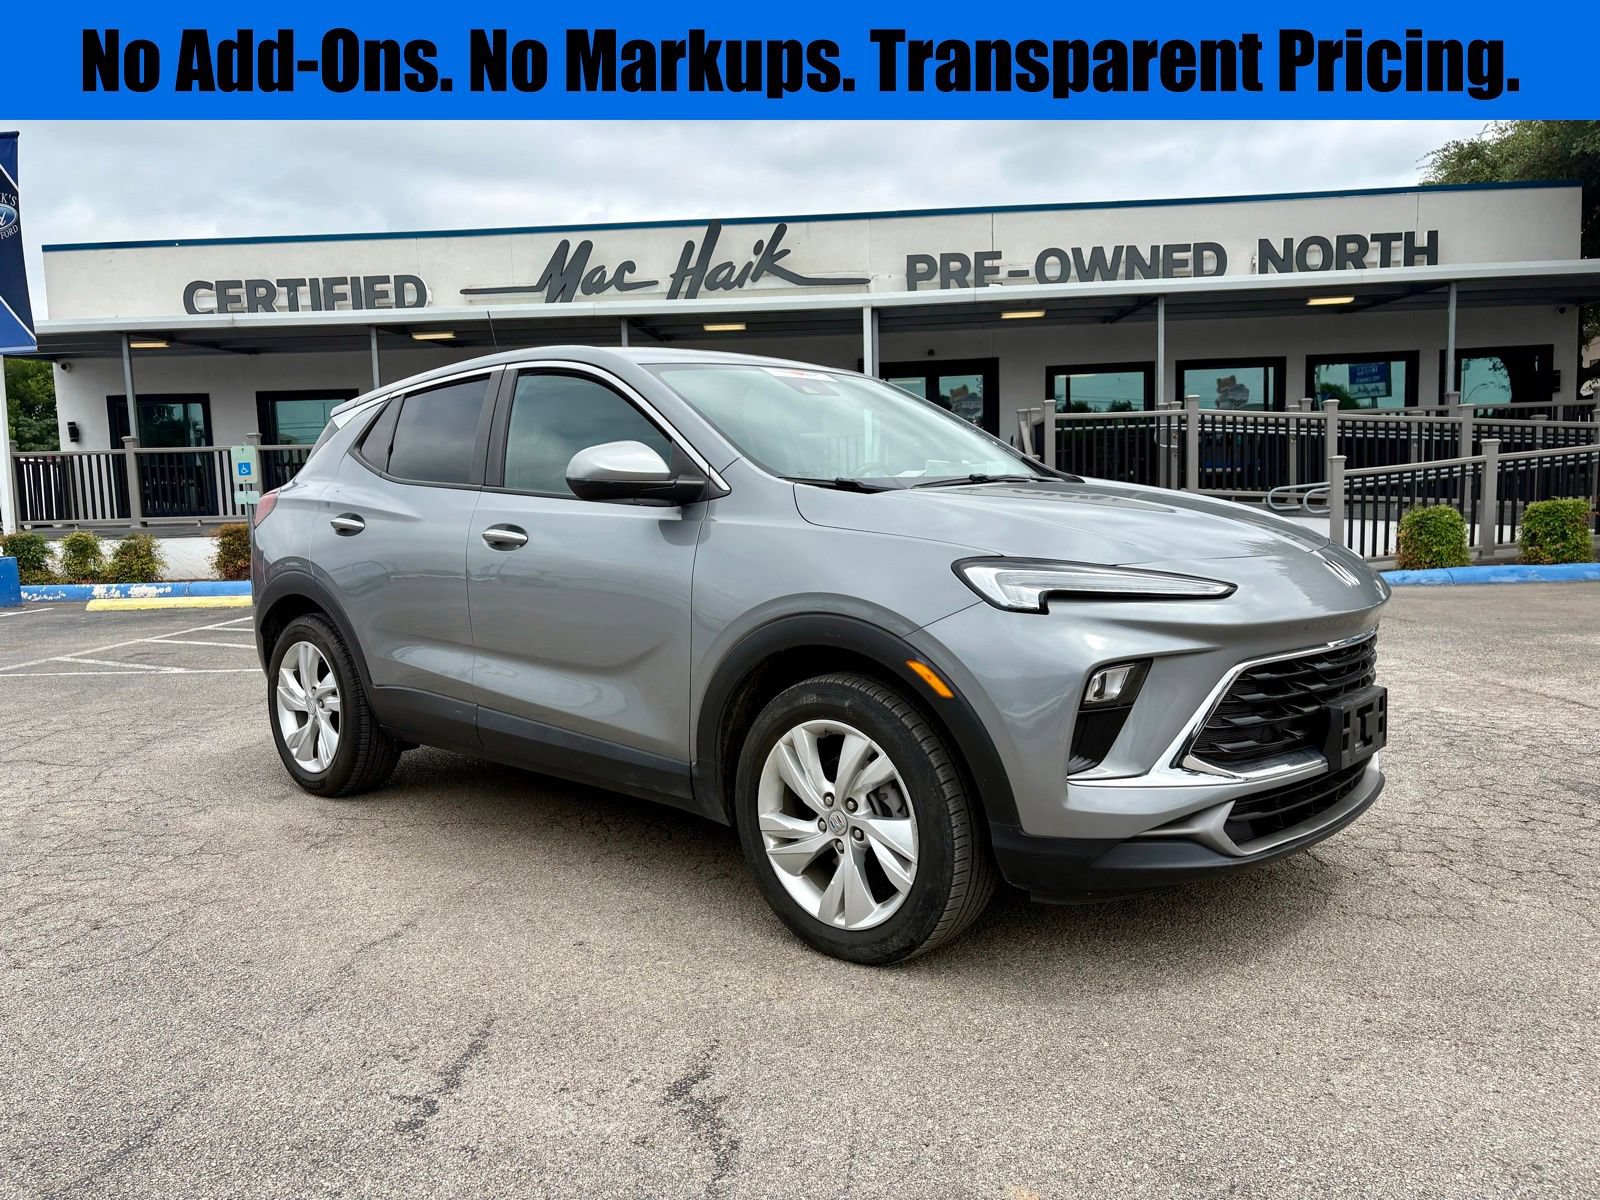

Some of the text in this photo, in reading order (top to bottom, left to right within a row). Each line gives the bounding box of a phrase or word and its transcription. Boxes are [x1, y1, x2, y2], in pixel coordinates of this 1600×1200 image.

[0, 193, 17, 207] K'S
[0, 224, 19, 240] FORD
[183, 218, 1439, 314] CERTIFIED Mac Haik PRE-OWNED NORTH
